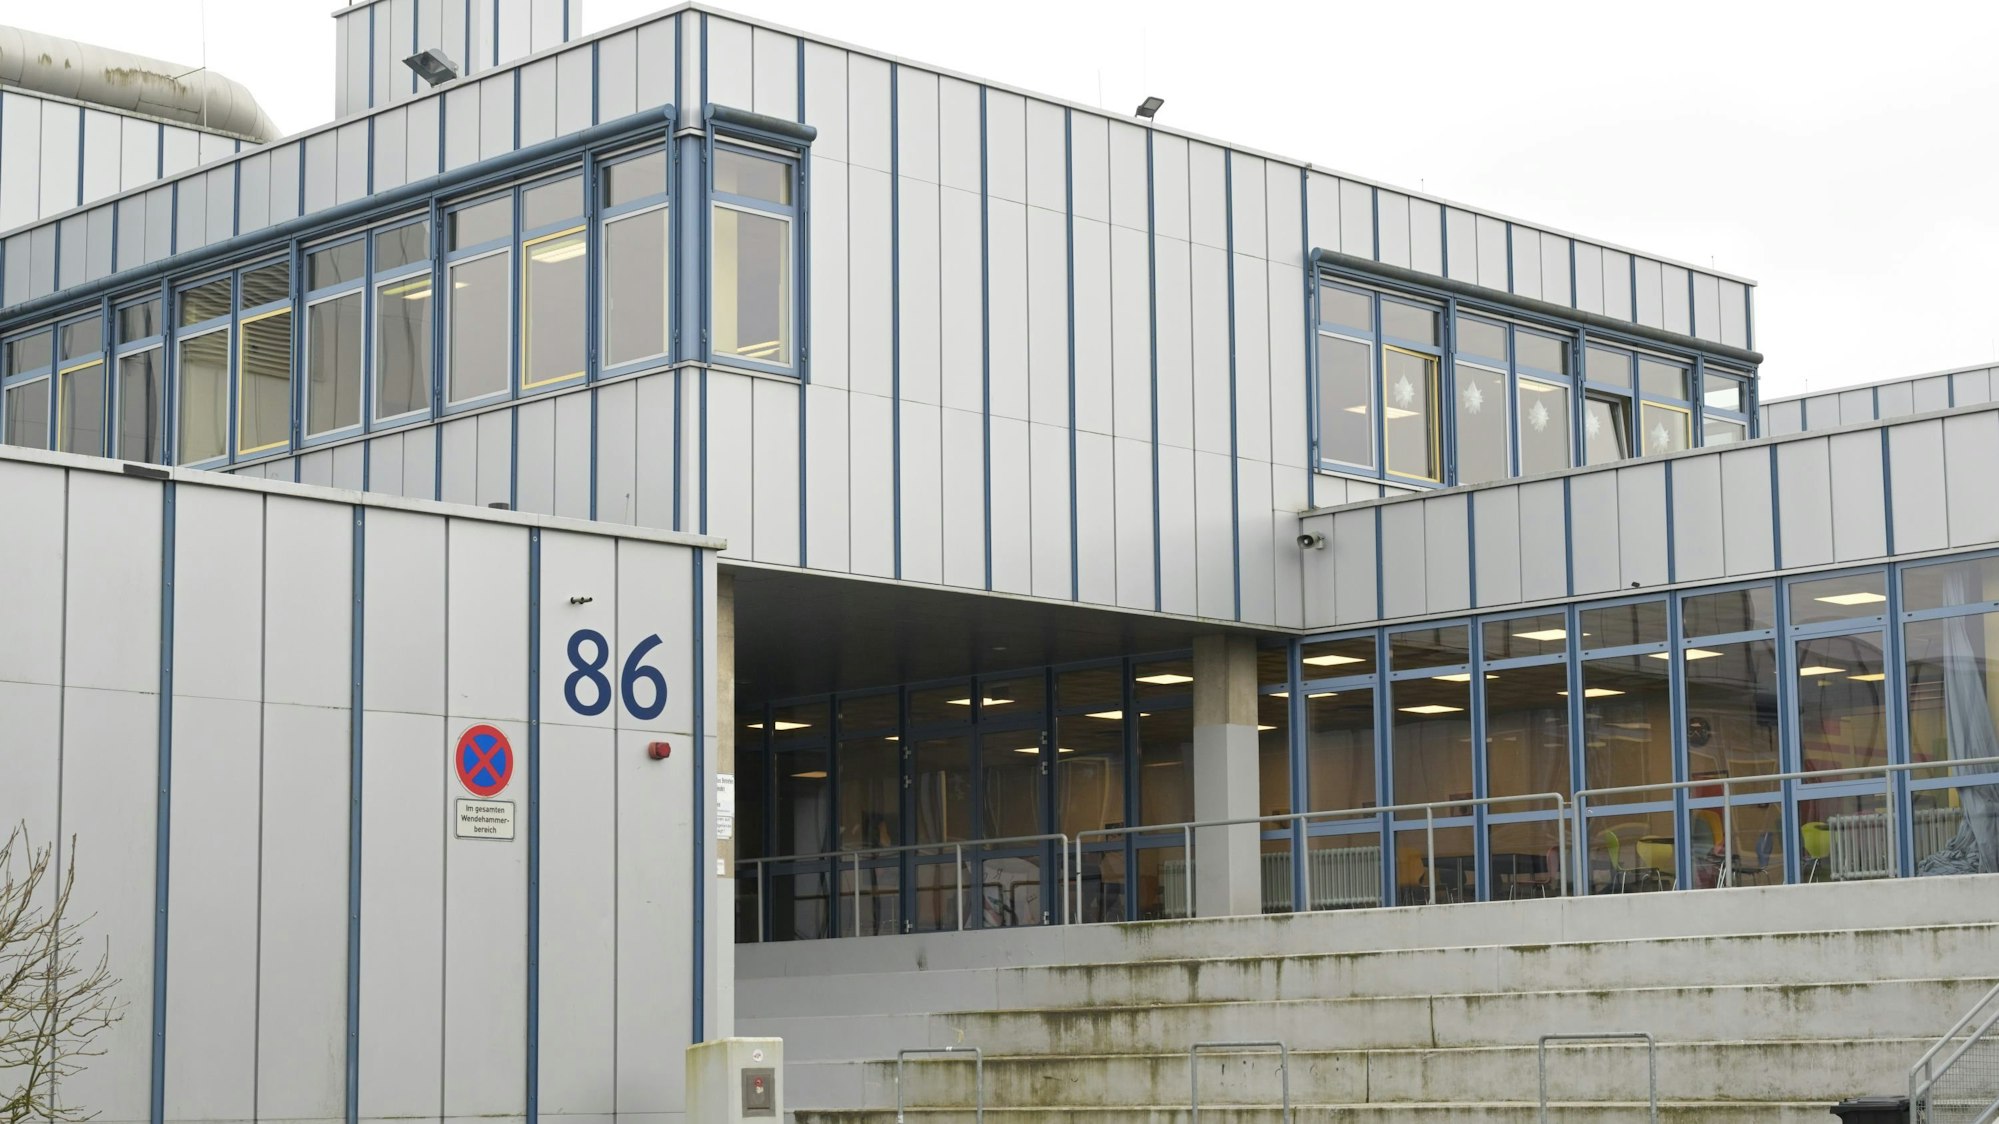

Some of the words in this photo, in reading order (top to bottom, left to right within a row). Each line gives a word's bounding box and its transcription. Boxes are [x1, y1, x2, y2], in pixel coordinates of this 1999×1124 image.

[564, 629, 667, 720] 86
[475, 806, 505, 814] gesamten
[460, 814, 509, 823] Wendehammer-
[473, 825, 497, 834] bereich
